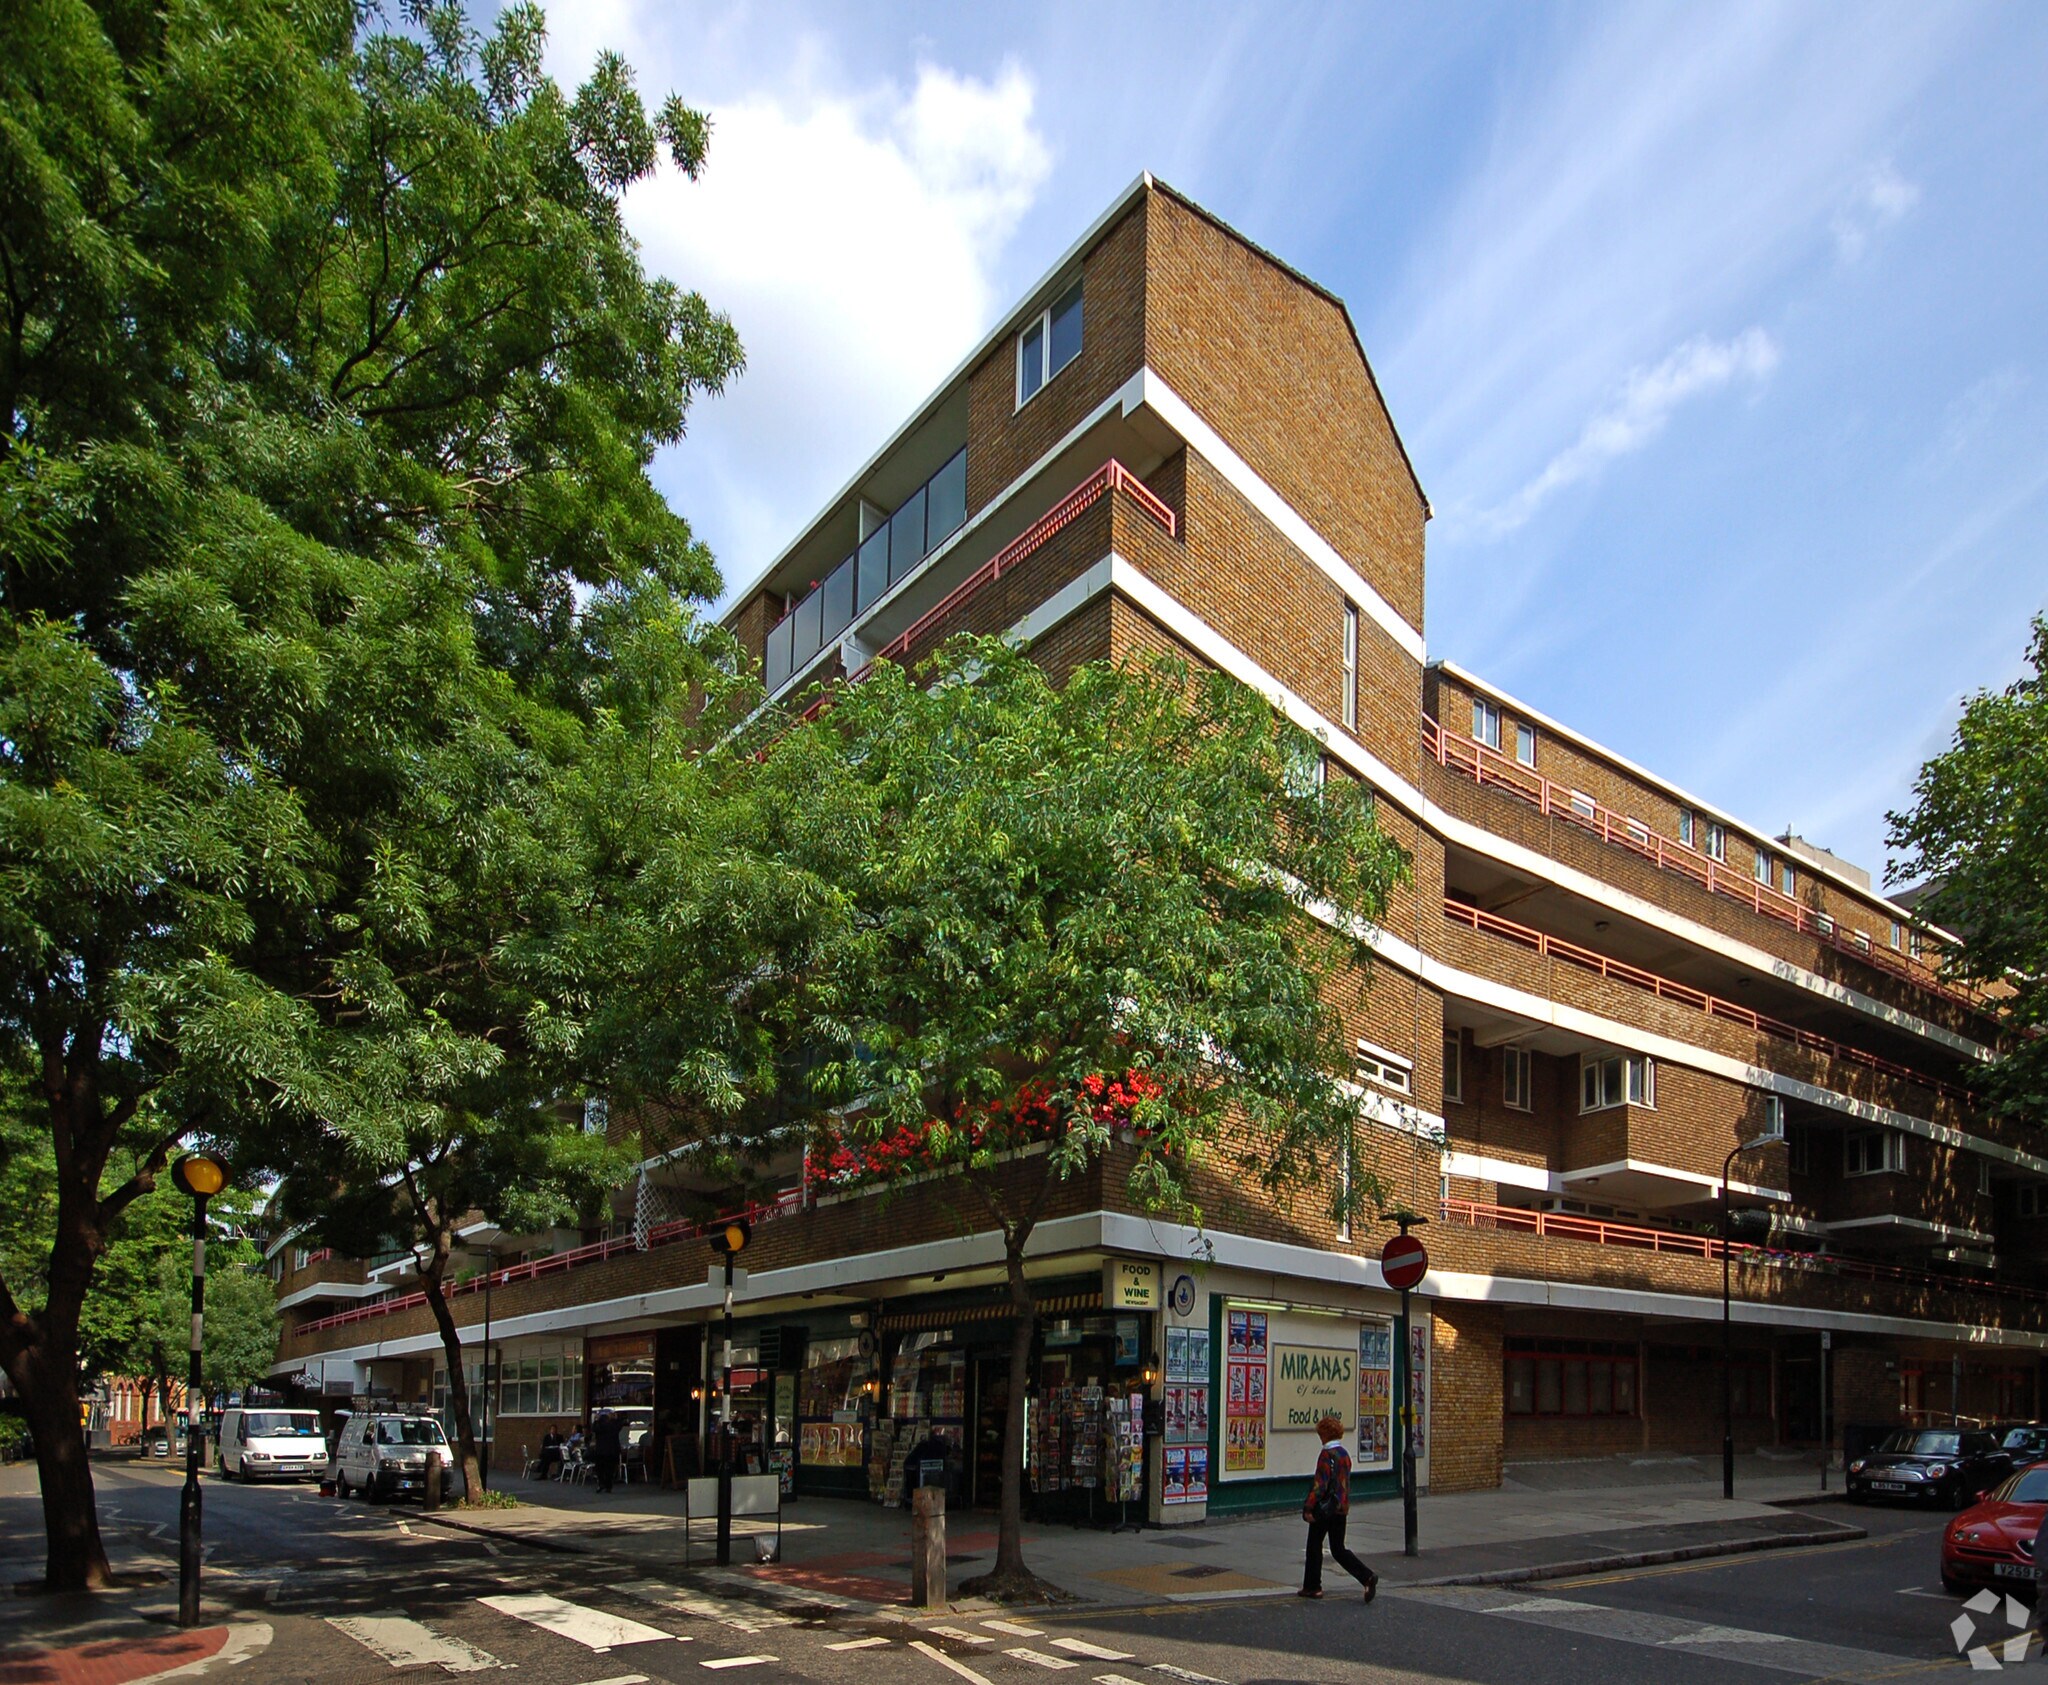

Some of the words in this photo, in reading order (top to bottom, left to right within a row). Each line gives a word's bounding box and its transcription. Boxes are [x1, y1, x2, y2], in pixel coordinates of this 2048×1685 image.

[1122, 1264, 1151, 1276] FOOD
[1133, 1277, 1140, 1286] &
[1123, 1287, 1150, 1298] WINE
[1280, 1352, 1351, 1382] MIRANAS
[1312, 1384, 1337, 1395] London
[1288, 1406, 1312, 1425] Food
[1312, 1409, 1319, 1424] &
[2000, 1564, 2030, 1578] V259
